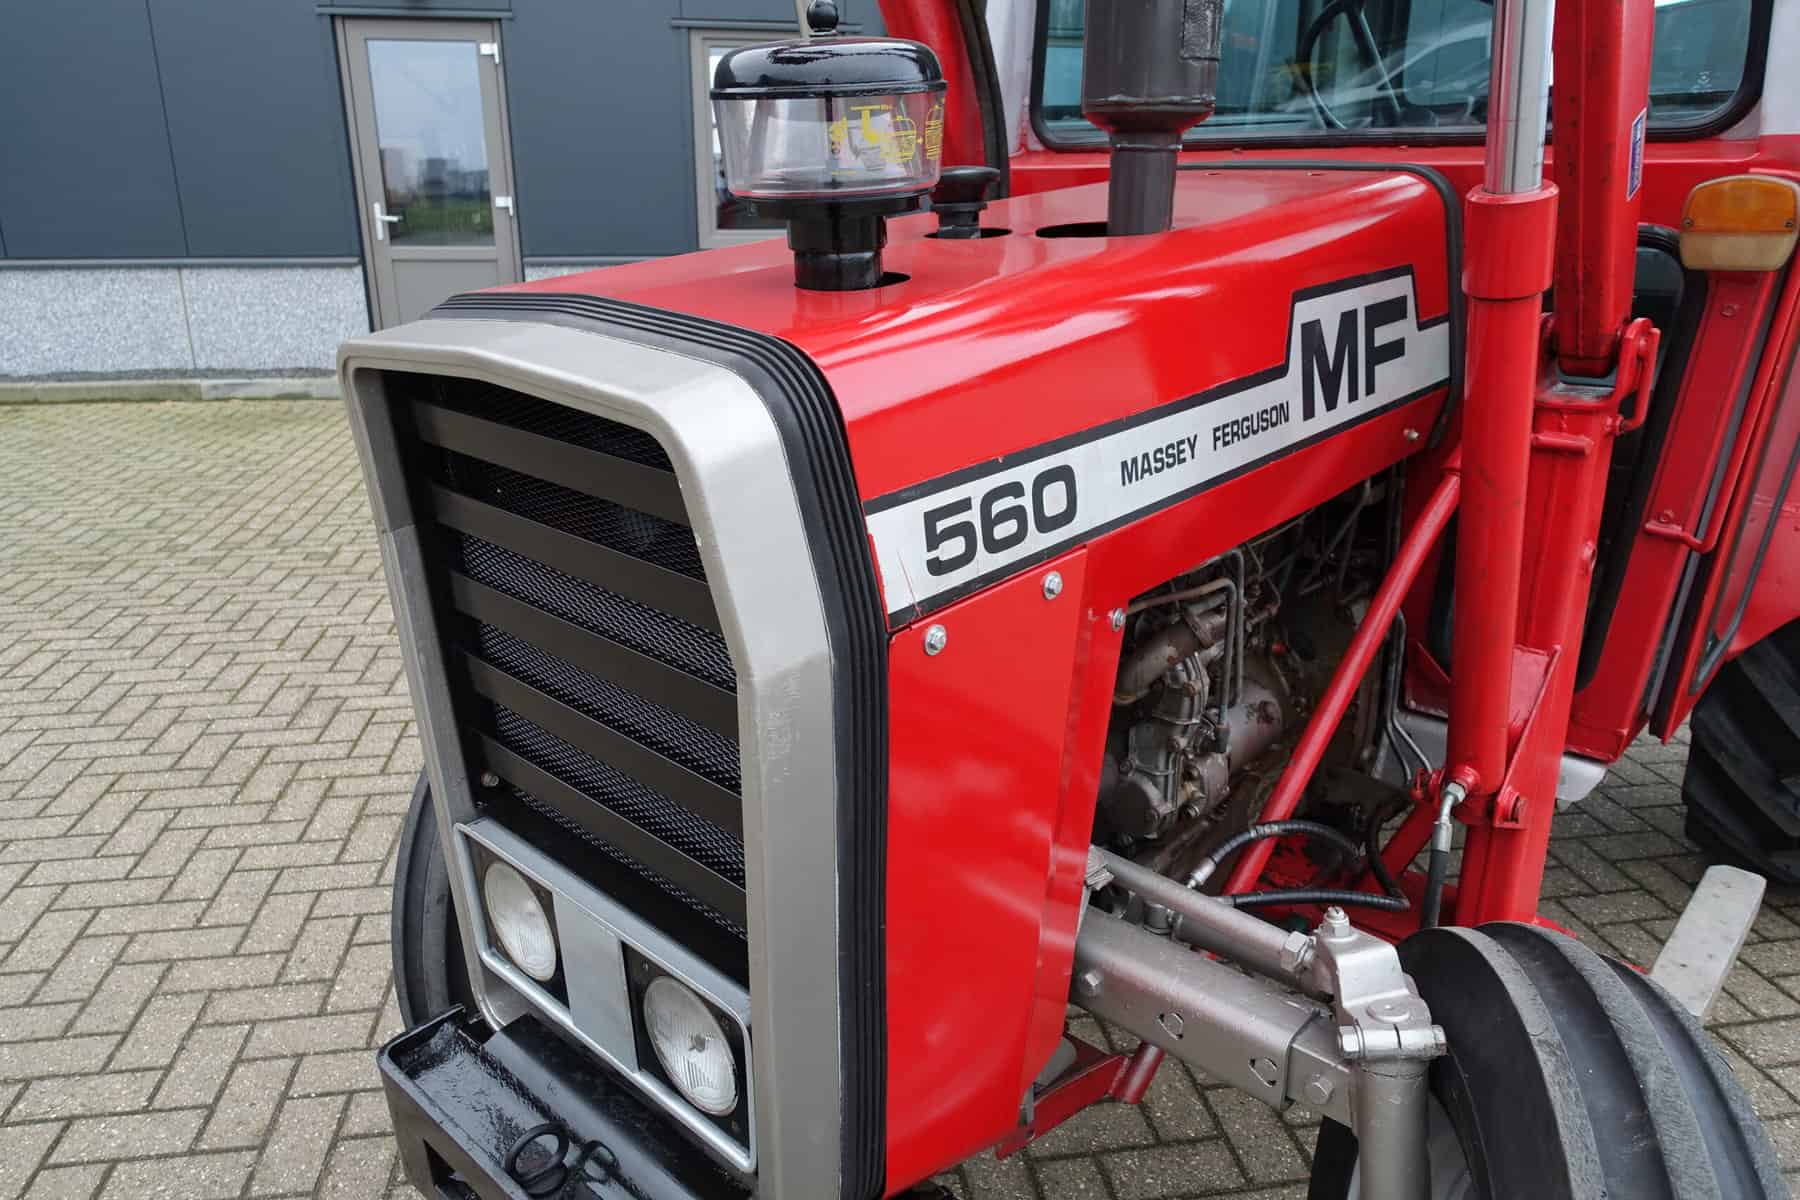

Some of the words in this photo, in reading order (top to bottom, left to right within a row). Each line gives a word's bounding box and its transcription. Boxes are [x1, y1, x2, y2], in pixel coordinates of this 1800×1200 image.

[922, 463, 1078, 577] 560
[1120, 434, 1198, 486] MASSEY
[1212, 401, 1290, 451] FERGUSON
[1300, 295, 1408, 422] MF
